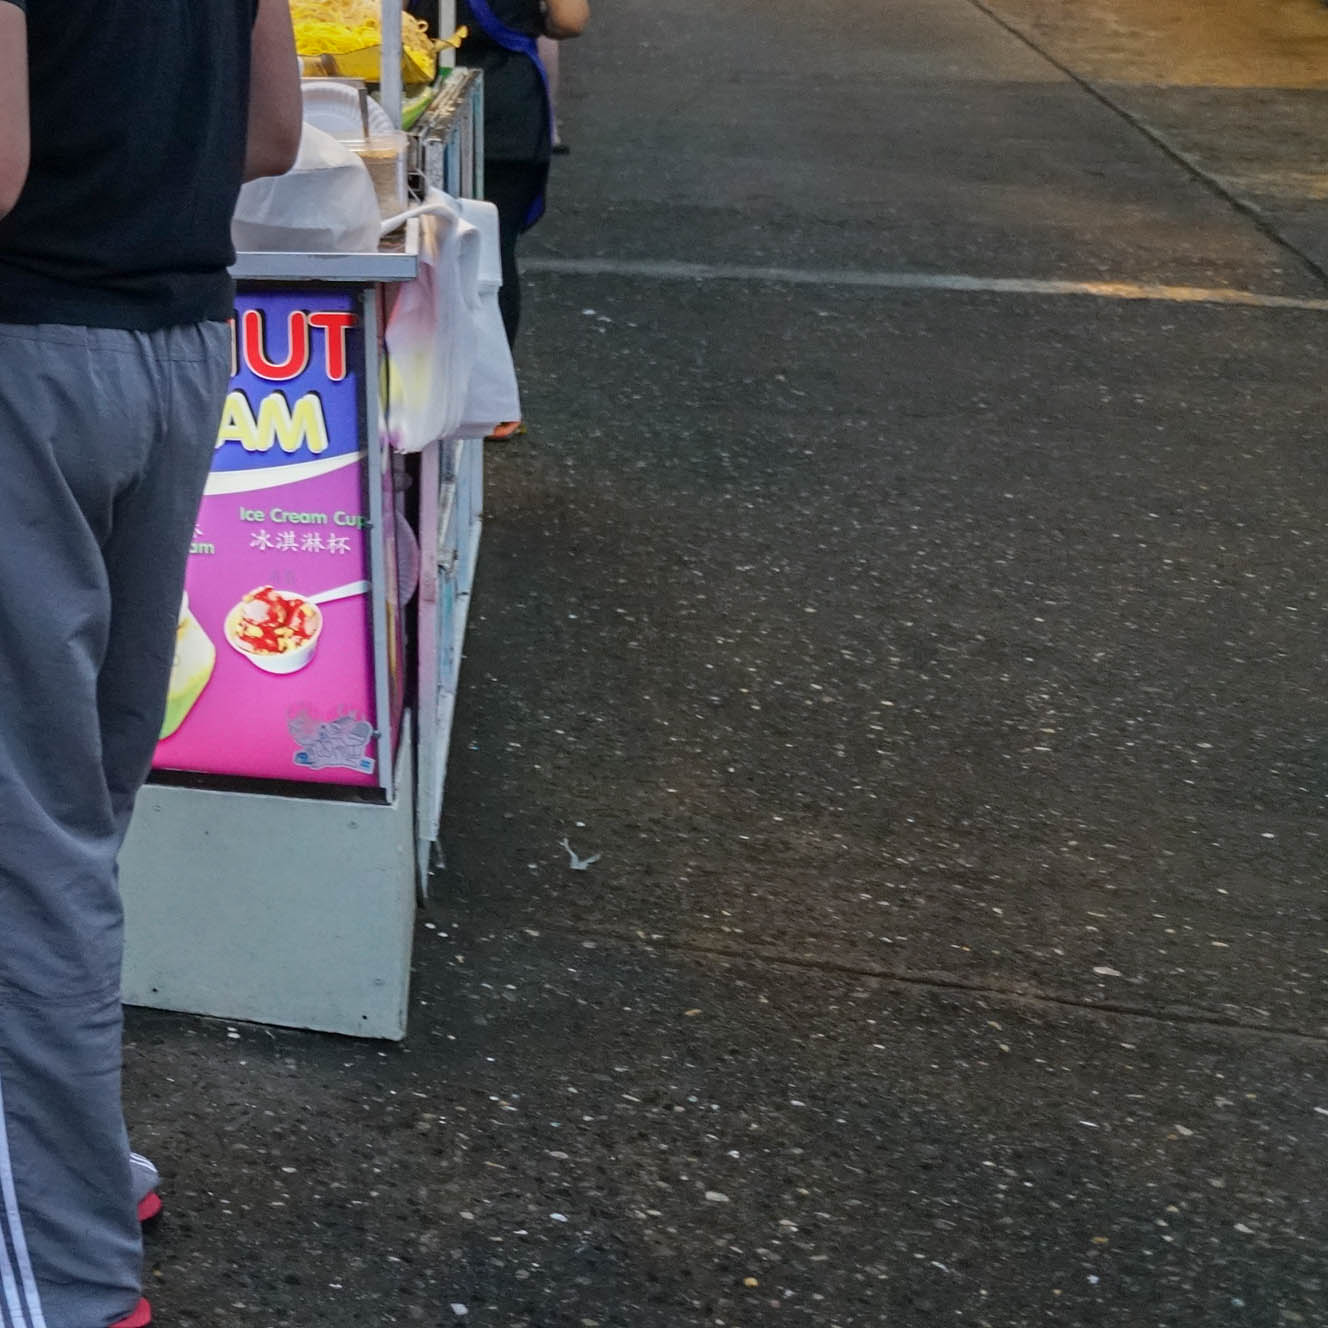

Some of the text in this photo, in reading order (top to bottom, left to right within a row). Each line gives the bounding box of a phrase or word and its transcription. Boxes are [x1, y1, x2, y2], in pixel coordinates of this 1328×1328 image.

[240, 506, 366, 530] Ice Cream Cup
